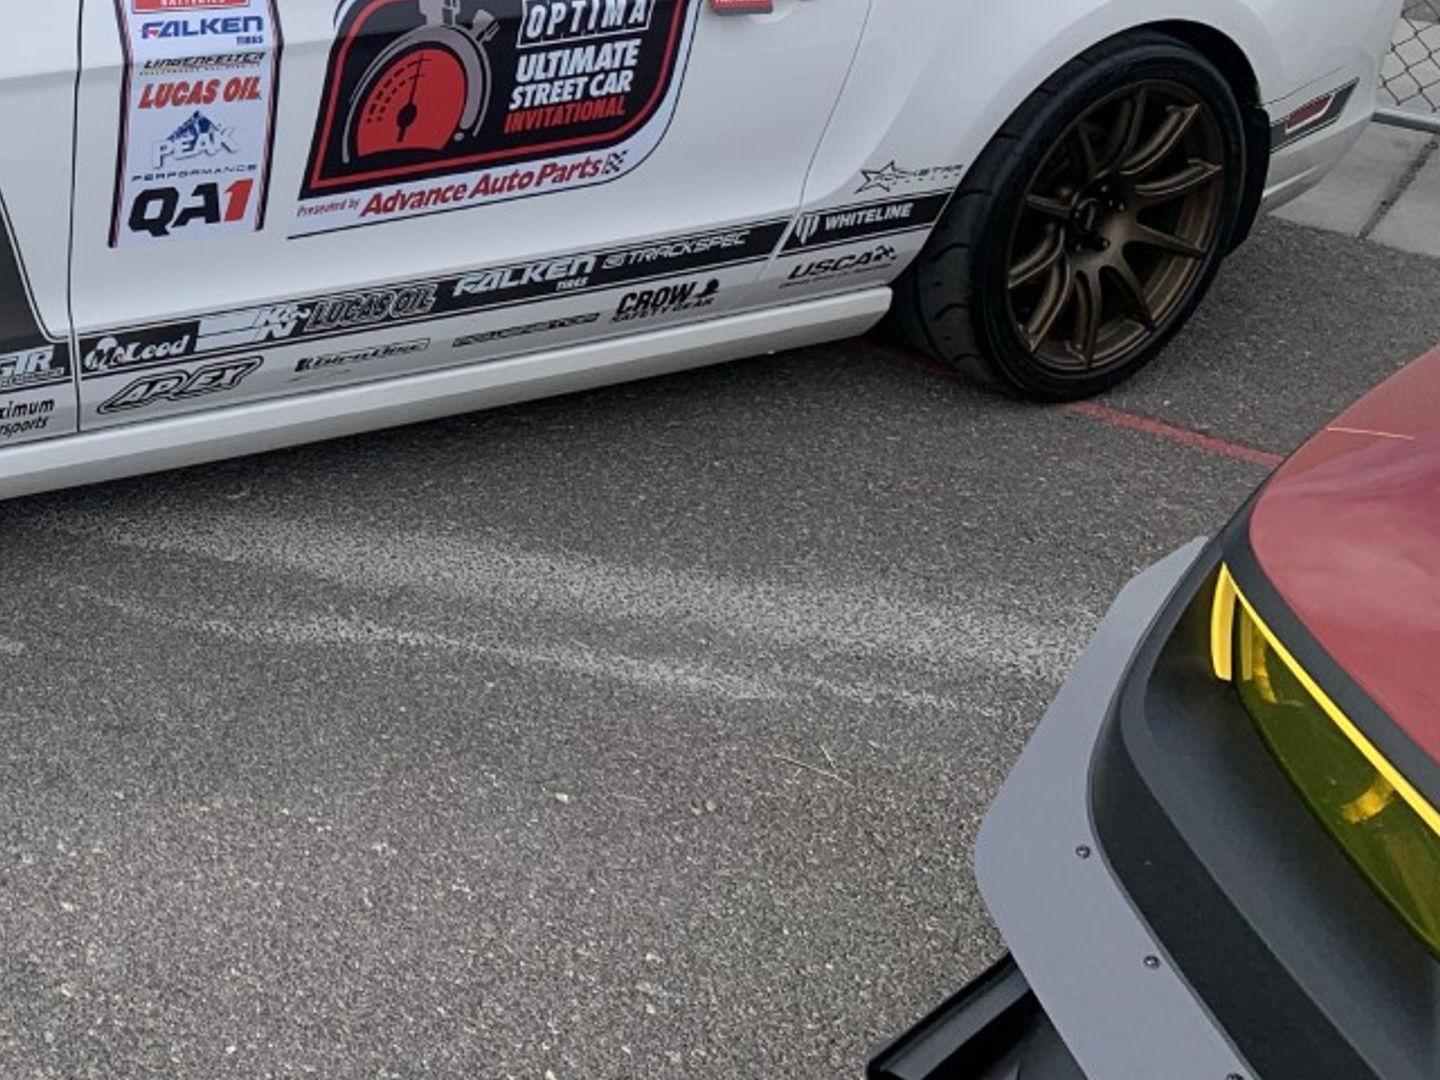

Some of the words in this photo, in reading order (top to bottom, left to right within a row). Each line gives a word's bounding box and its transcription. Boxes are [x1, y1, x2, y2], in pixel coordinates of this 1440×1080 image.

[141, 16, 264, 39] FALKEN
[515, 39, 642, 83] ULTIMATE
[138, 79, 220, 109] LUCAS
[223, 76, 262, 102] OIL
[509, 77, 588, 110] STREET
[589, 70, 634, 96] CAR
[504, 96, 625, 134] INVITATIONAL
[152, 124, 238, 170] PEAK
[359, 183, 467, 217] Advance
[467, 170, 534, 199] Auto
[534, 155, 604, 187] Parts
[128, 178, 254, 237] QA1
[85, 336, 190, 370] McLeod
[304, 288, 395, 332] LUCAS
[388, 284, 437, 319] OIL
[453, 254, 596, 297] FALKEN
[629, 229, 750, 264] TRACKSPEC
[825, 202, 914, 230] WHITELINE
[617, 281, 698, 314] CROW
[611, 307, 668, 322] SAFETY
[671, 297, 715, 312] GEAR
